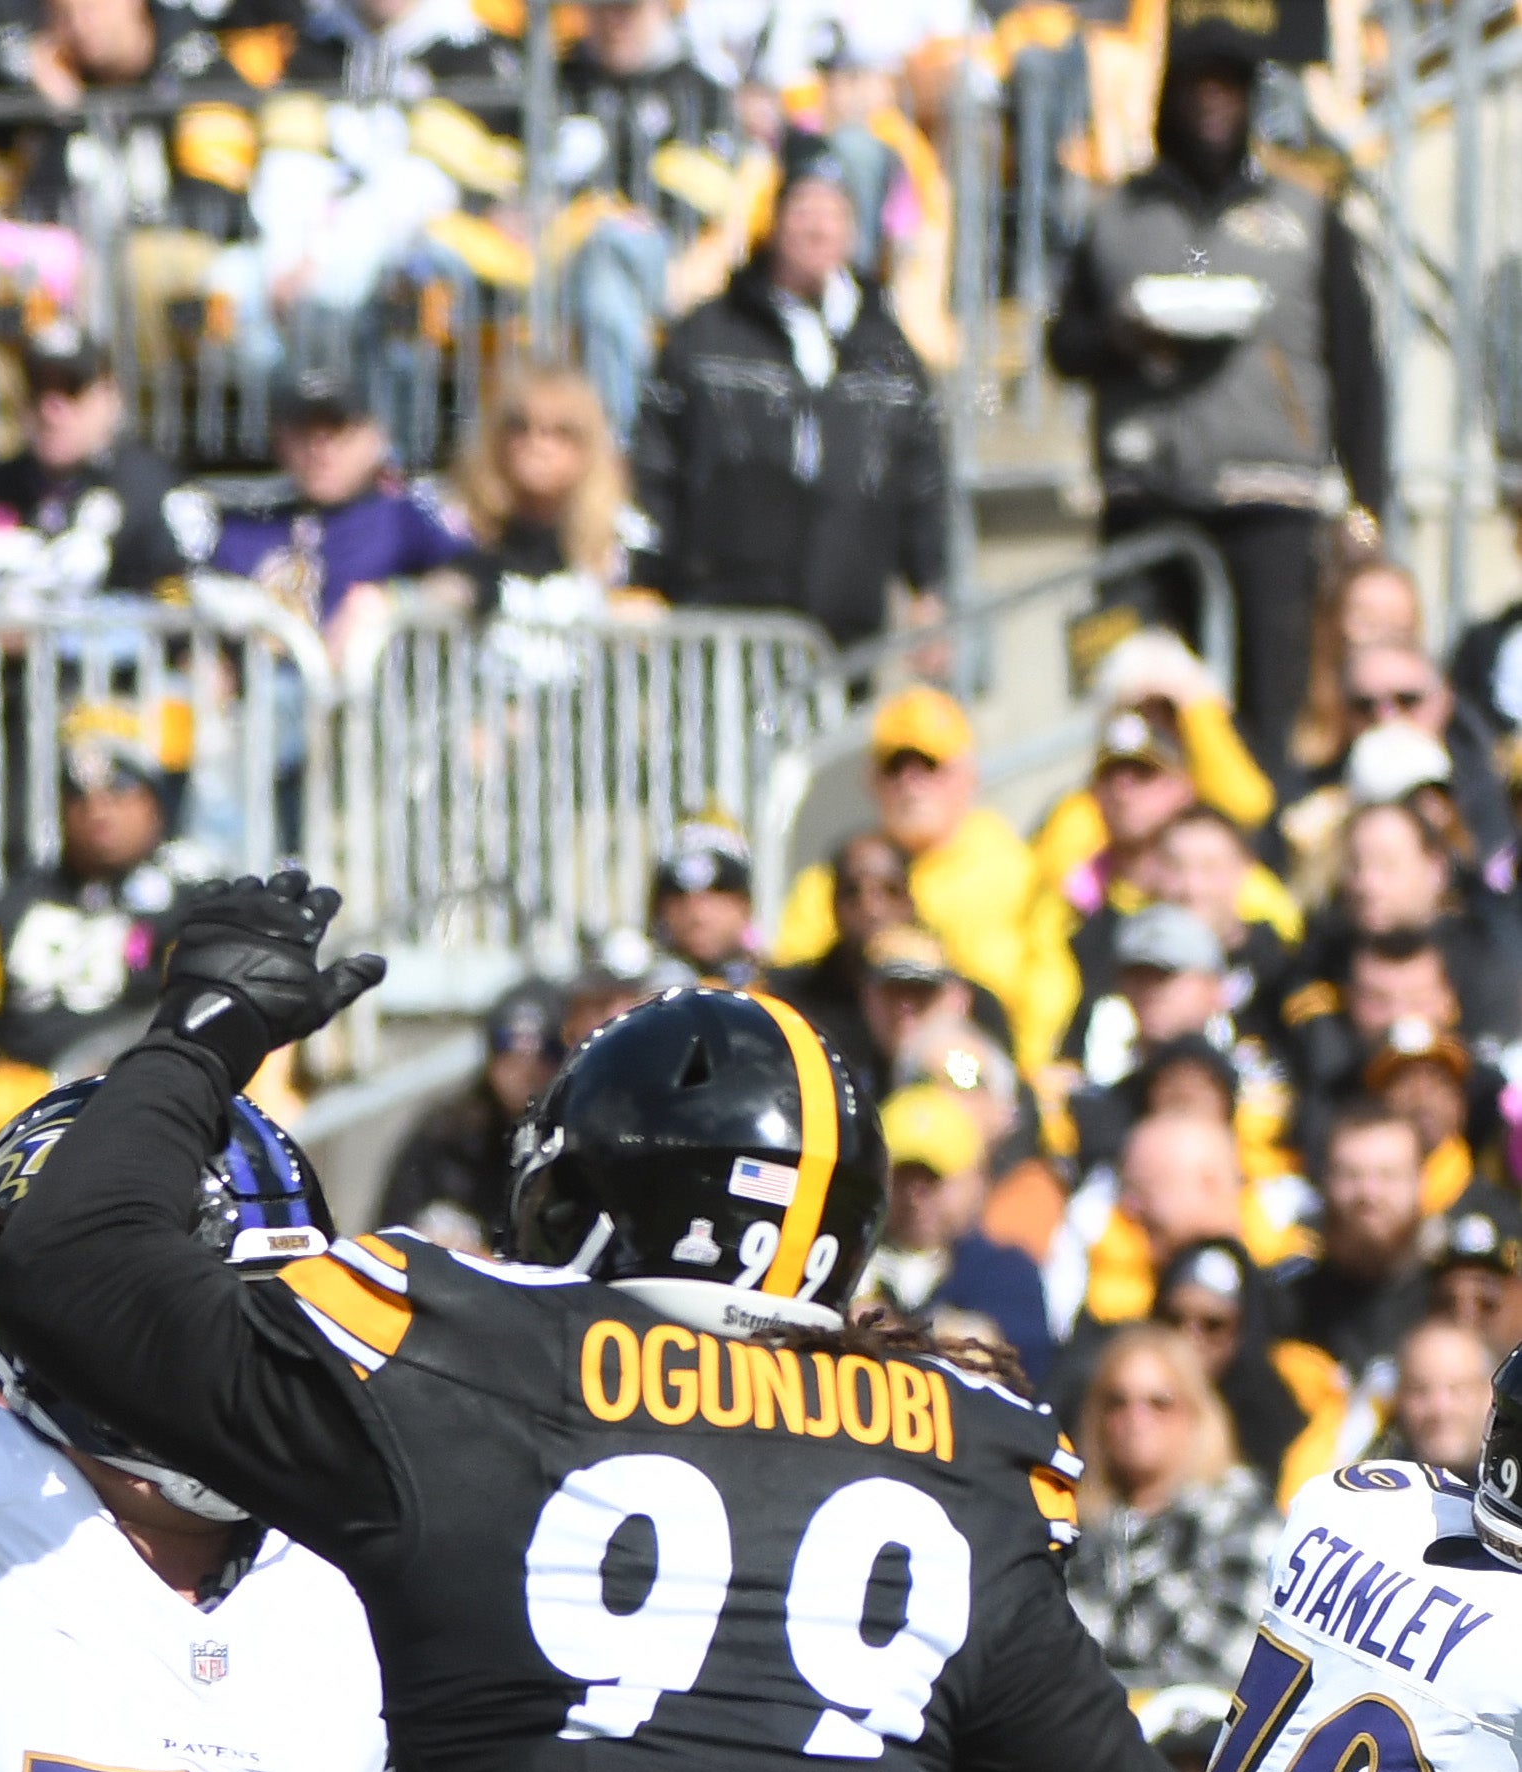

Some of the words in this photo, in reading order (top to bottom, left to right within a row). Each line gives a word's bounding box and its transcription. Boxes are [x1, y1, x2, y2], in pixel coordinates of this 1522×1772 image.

[731, 1219, 841, 1303] 99
[579, 1319, 956, 1464] OGUNJOBI
[524, 1453, 972, 1760] 99
[1273, 1525, 1495, 1684] STANLEY
